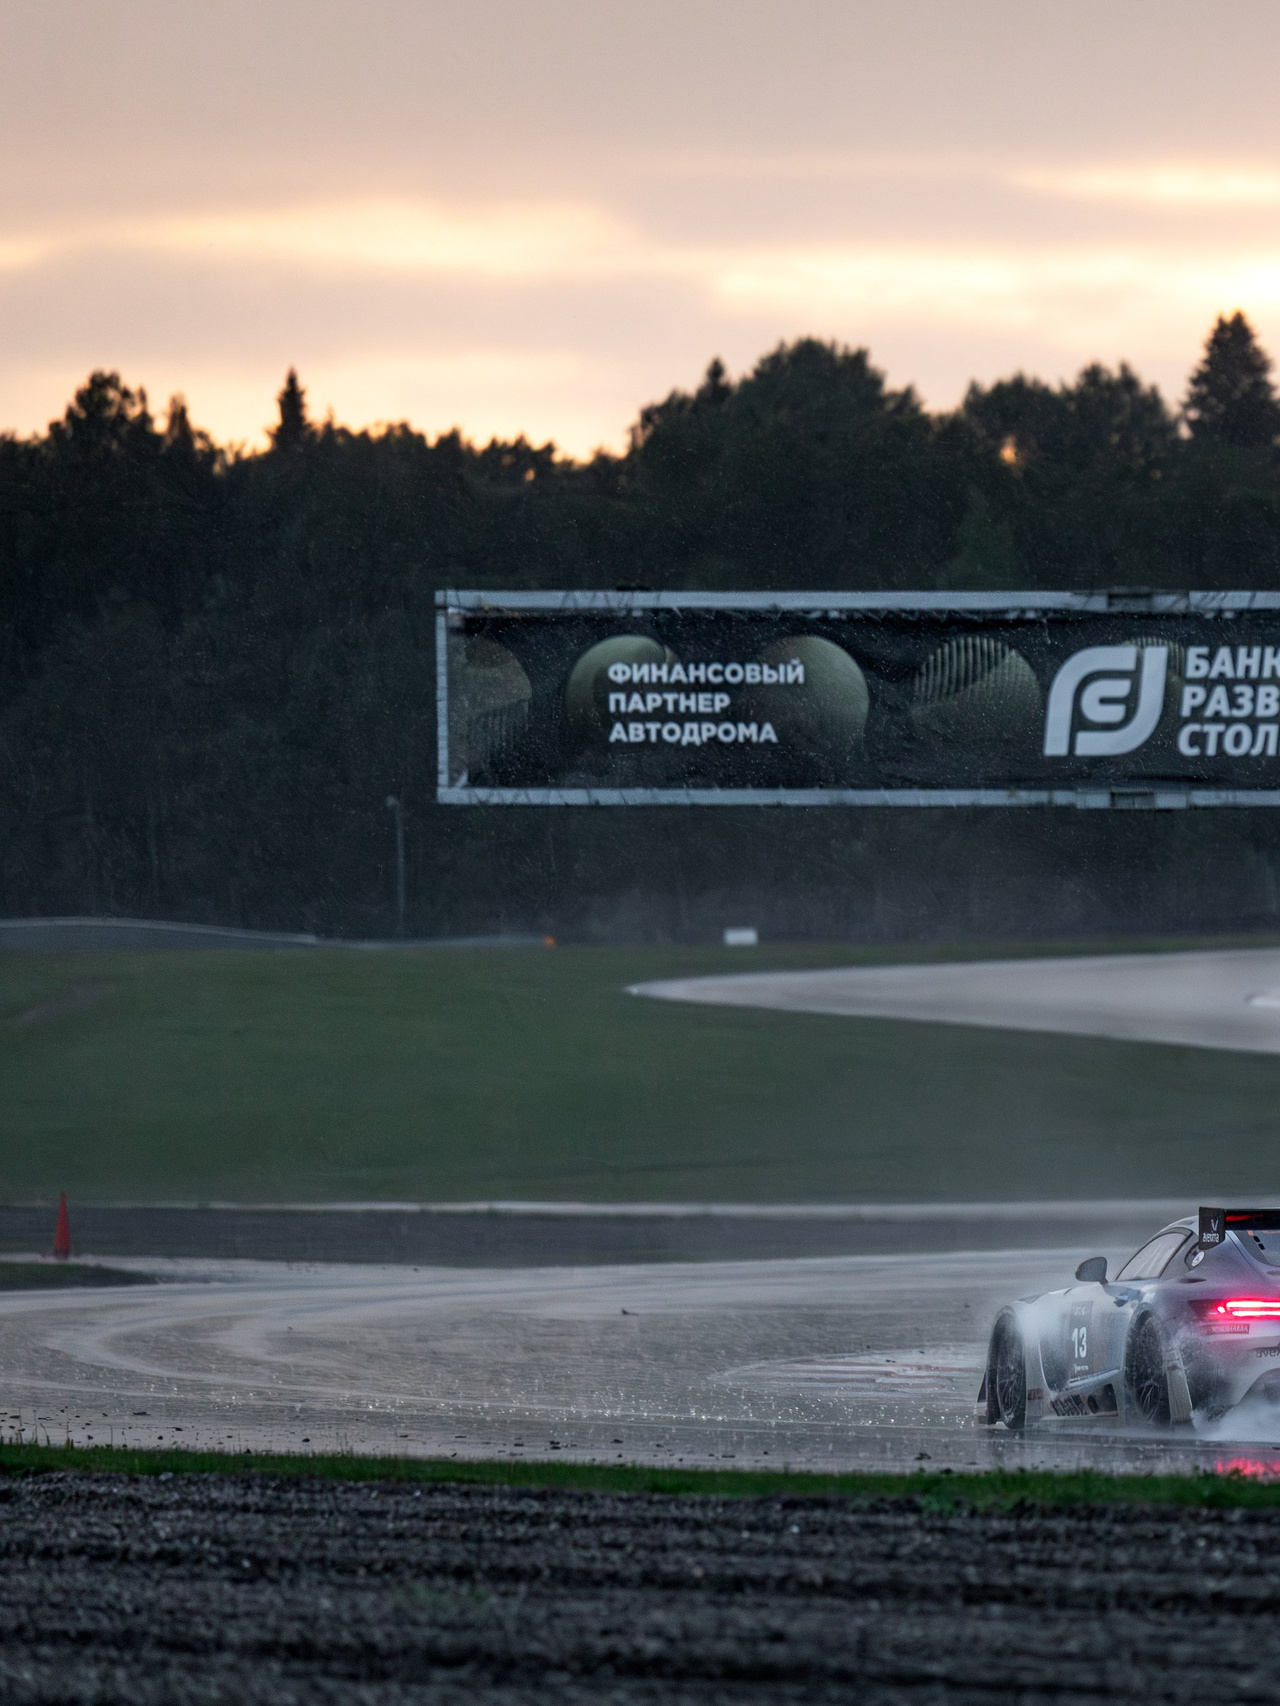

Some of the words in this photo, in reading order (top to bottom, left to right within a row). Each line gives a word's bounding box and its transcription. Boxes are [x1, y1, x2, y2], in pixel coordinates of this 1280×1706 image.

[607, 658, 805, 684] ФИНАНСОВЫЙ
[608, 692, 731, 713] ПАРТНЕР
[608, 721, 778, 746] АВТОДРОМА
[1071, 1326, 1088, 1359] 13
